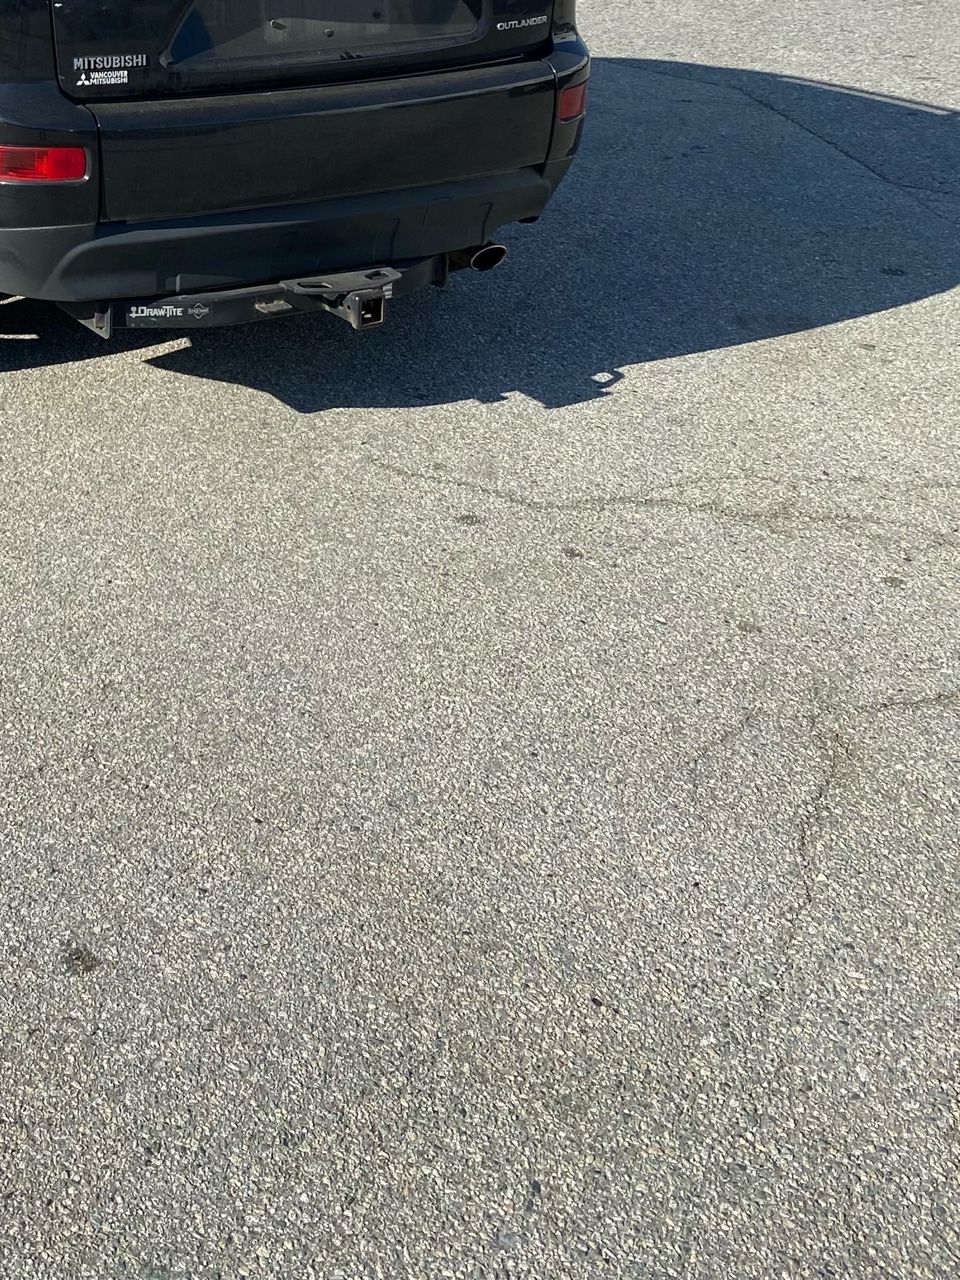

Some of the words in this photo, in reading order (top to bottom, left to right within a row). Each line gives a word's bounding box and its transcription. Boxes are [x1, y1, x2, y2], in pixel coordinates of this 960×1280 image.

[496, 15, 548, 31] OUTLANDER
[73, 54, 147, 70] MITSUBISHI
[90, 70, 128, 78] VANCOUVER
[89, 77, 128, 85] MITSUBISHI
